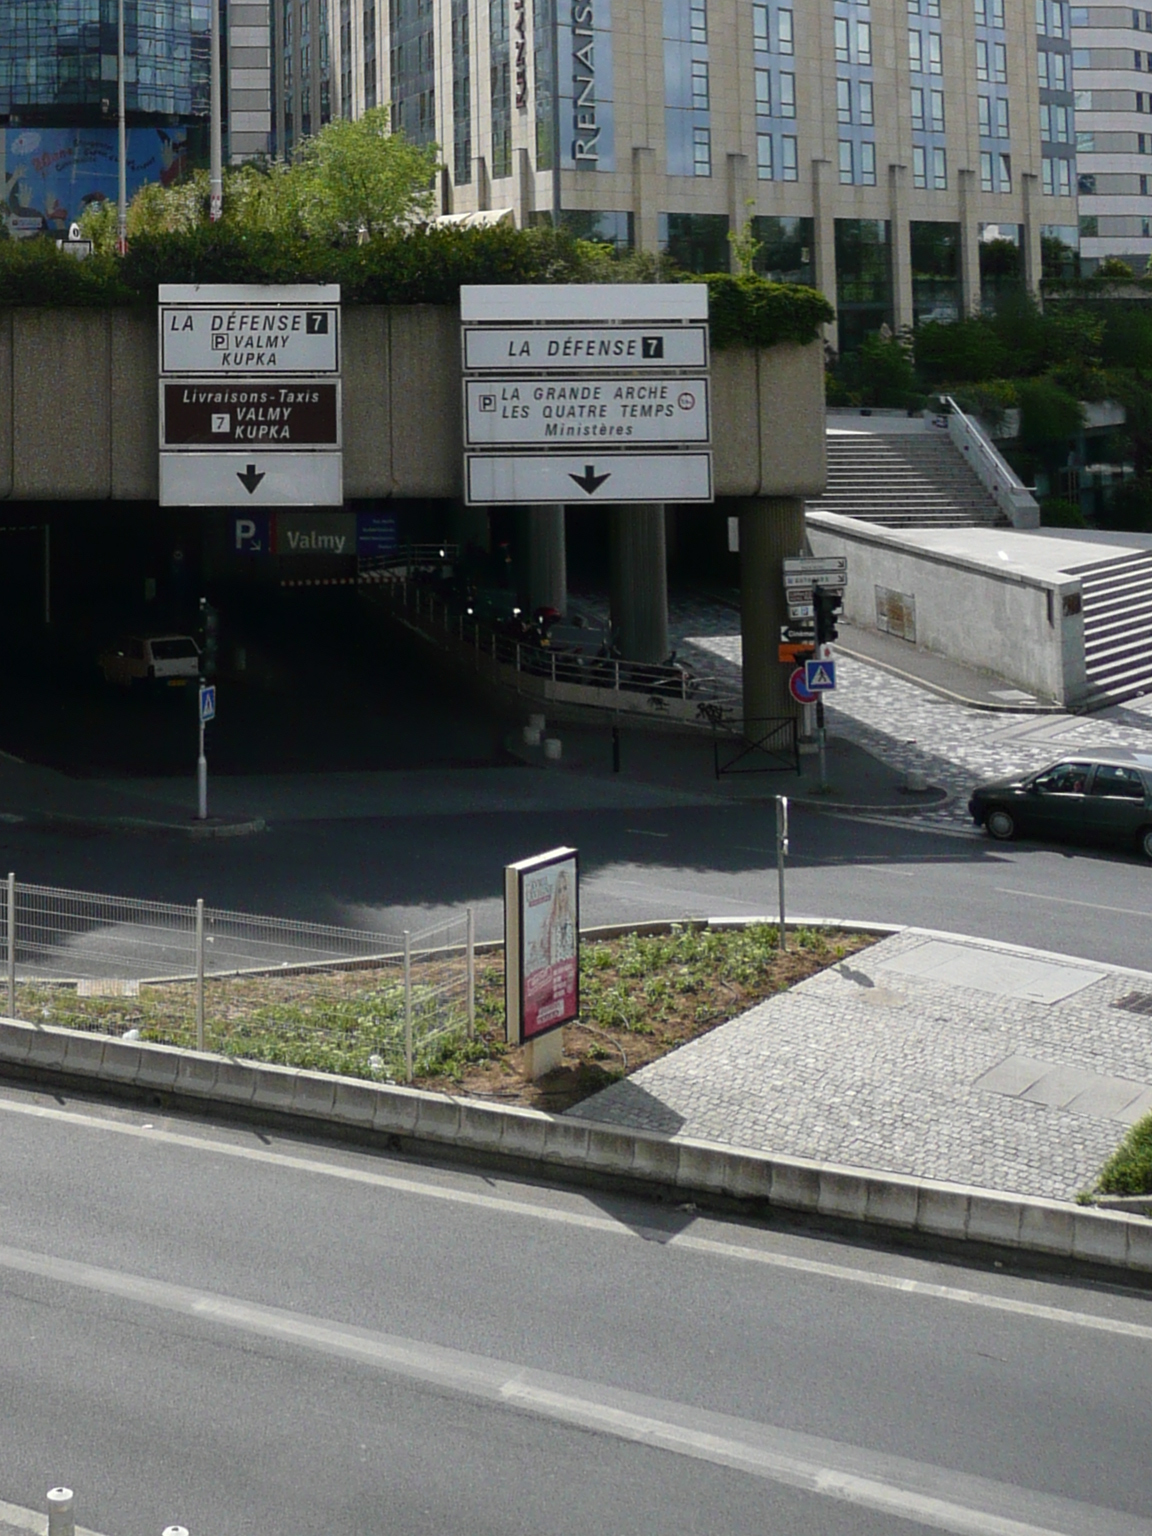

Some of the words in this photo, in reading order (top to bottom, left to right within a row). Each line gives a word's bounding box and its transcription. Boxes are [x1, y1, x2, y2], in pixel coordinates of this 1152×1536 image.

[171, 315, 194, 331] LA
[211, 312, 302, 331] DÉFENSE
[312, 315, 323, 331] 7
[234, 335, 290, 348] VALMY
[508, 341, 531, 356] LA
[548, 336, 636, 356] DÉFENSE
[647, 339, 659, 355] 7
[222, 352, 277, 366] KUPKA
[183, 389, 320, 404] Livraisons-Taxis
[501, 388, 520, 401] LA
[533, 387, 602, 400] GRANDE
[614, 386, 669, 400] ARCHE
[236, 407, 293, 421] VALMY
[501, 405, 530, 419] LES
[542, 404, 608, 418] QUATRE
[621, 404, 675, 418] TEMPS
[216, 416, 225, 430] 7
[544, 422, 634, 437] Ministères
[235, 425, 291, 439] KUPKA
[234, 518, 257, 550] P
[287, 530, 346, 554] Valmy
